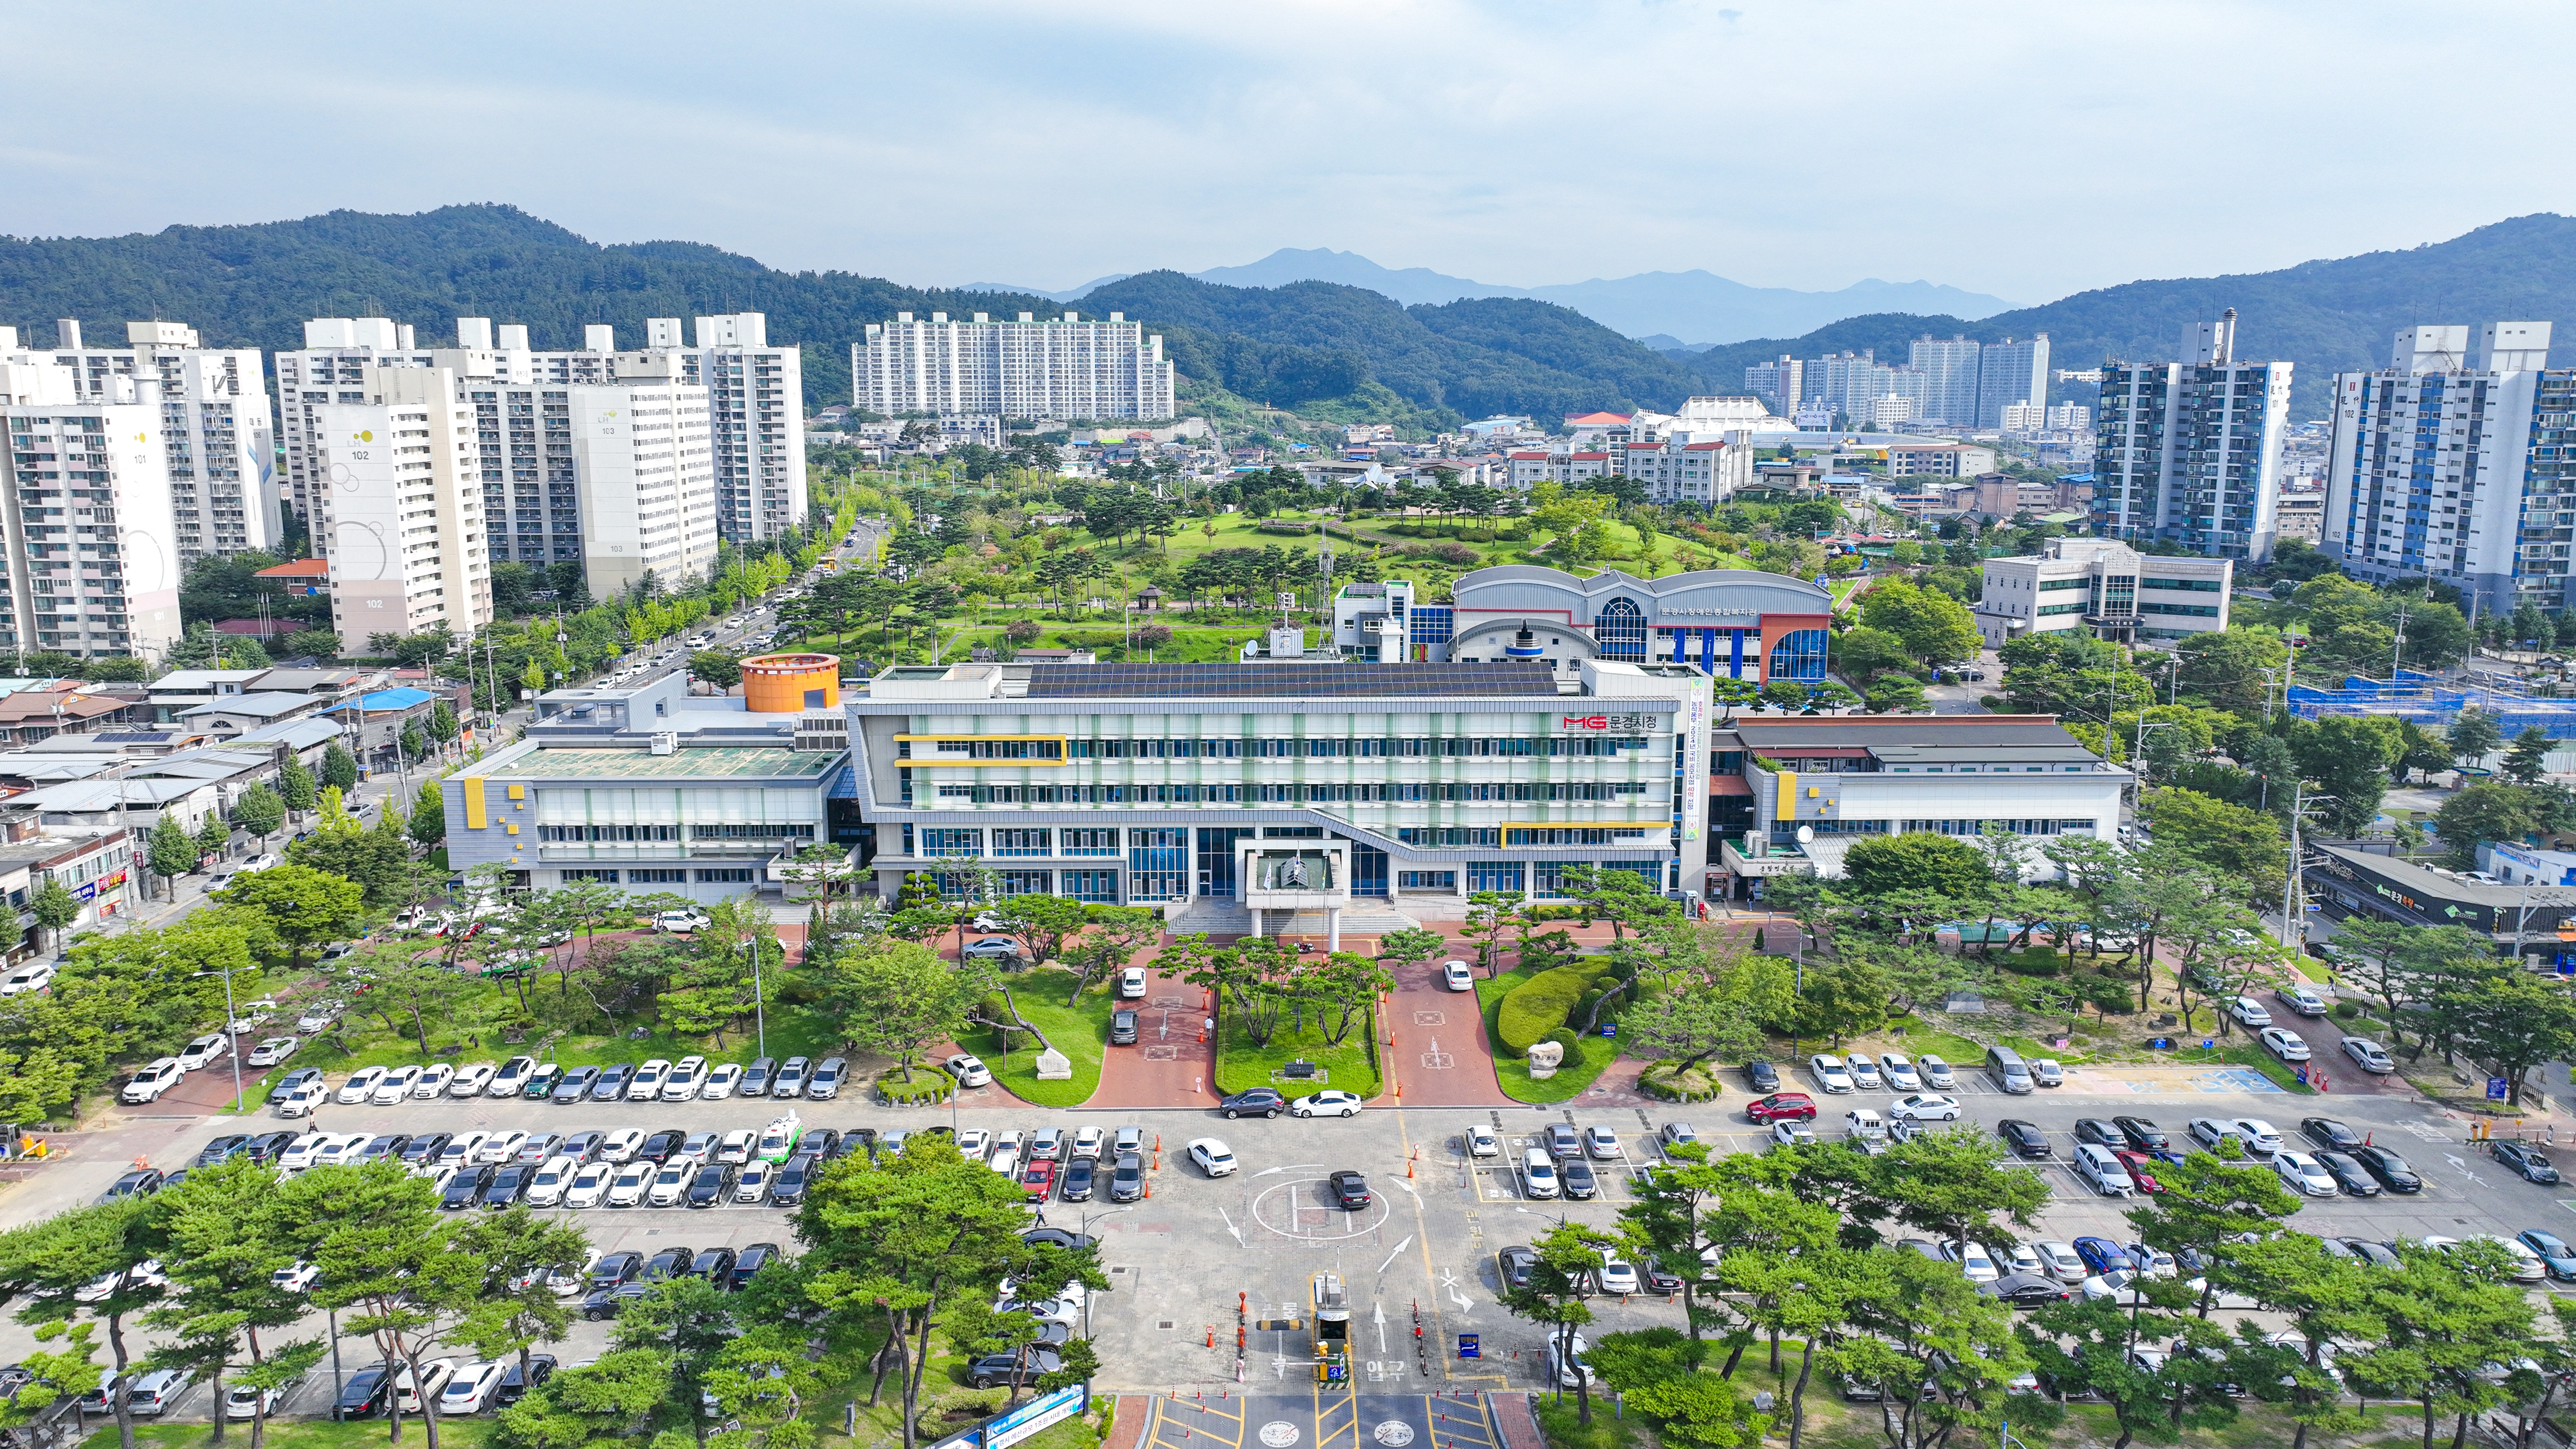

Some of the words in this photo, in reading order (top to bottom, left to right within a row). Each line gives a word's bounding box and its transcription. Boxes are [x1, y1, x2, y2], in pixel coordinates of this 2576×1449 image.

[2344, 410, 2355, 418] 102
[134, 454, 146, 464] 101
[352, 451, 369, 460] 102
[366, 599, 383, 608] 102
[153, 611, 165, 621] 101
[1564, 716, 1607, 729] MG
[1610, 716, 1656, 729] 문경시청
[1489, 1189, 1514, 1198] 경차
[1366, 1360, 1405, 1382] 입구
[994, 1437, 1010, 1449] 문경시
[1011, 1425, 1033, 1440] 예산규모
[1034, 1417, 1048, 1428] 1조원
[1050, 1410, 1060, 1420] 시대
